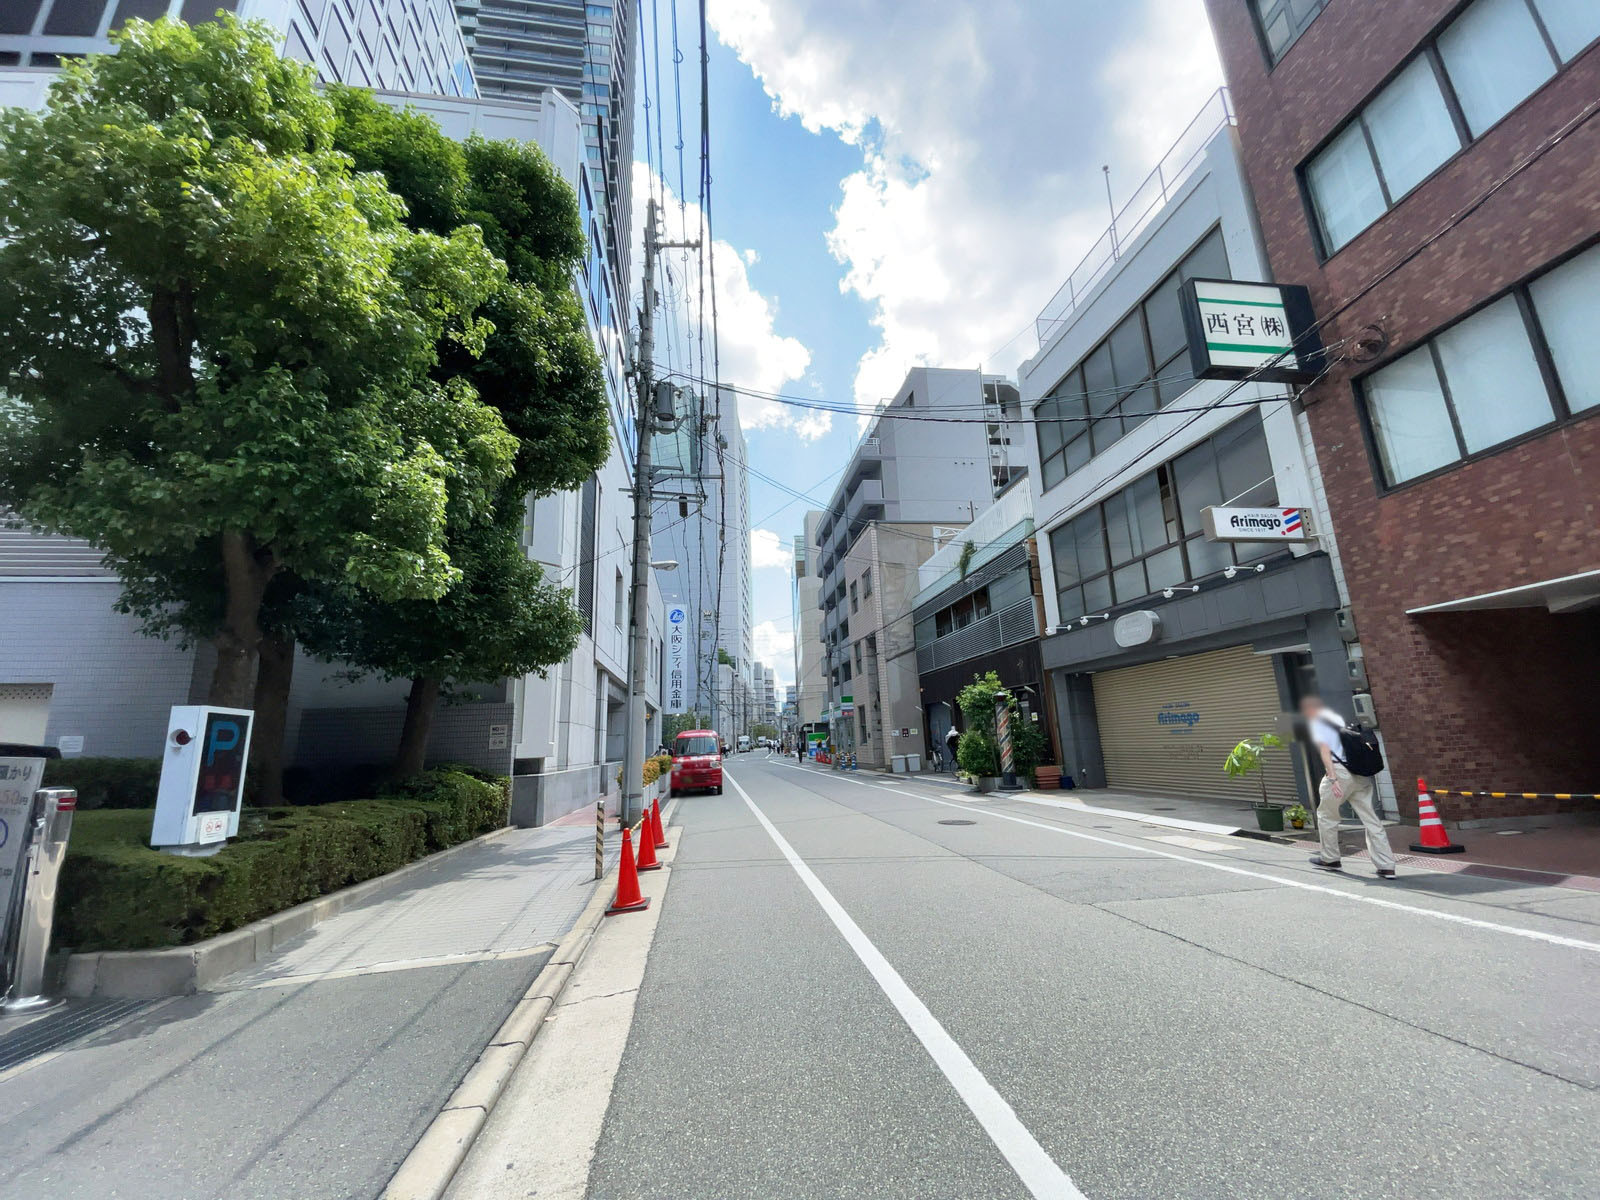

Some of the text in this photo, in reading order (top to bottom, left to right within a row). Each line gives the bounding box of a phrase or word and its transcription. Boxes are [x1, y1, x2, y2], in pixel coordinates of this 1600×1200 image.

[1230, 515, 1281, 530] Arimago
[671, 625, 683, 709] 大阪シティ信用金庫
[207, 721, 239, 767] P
